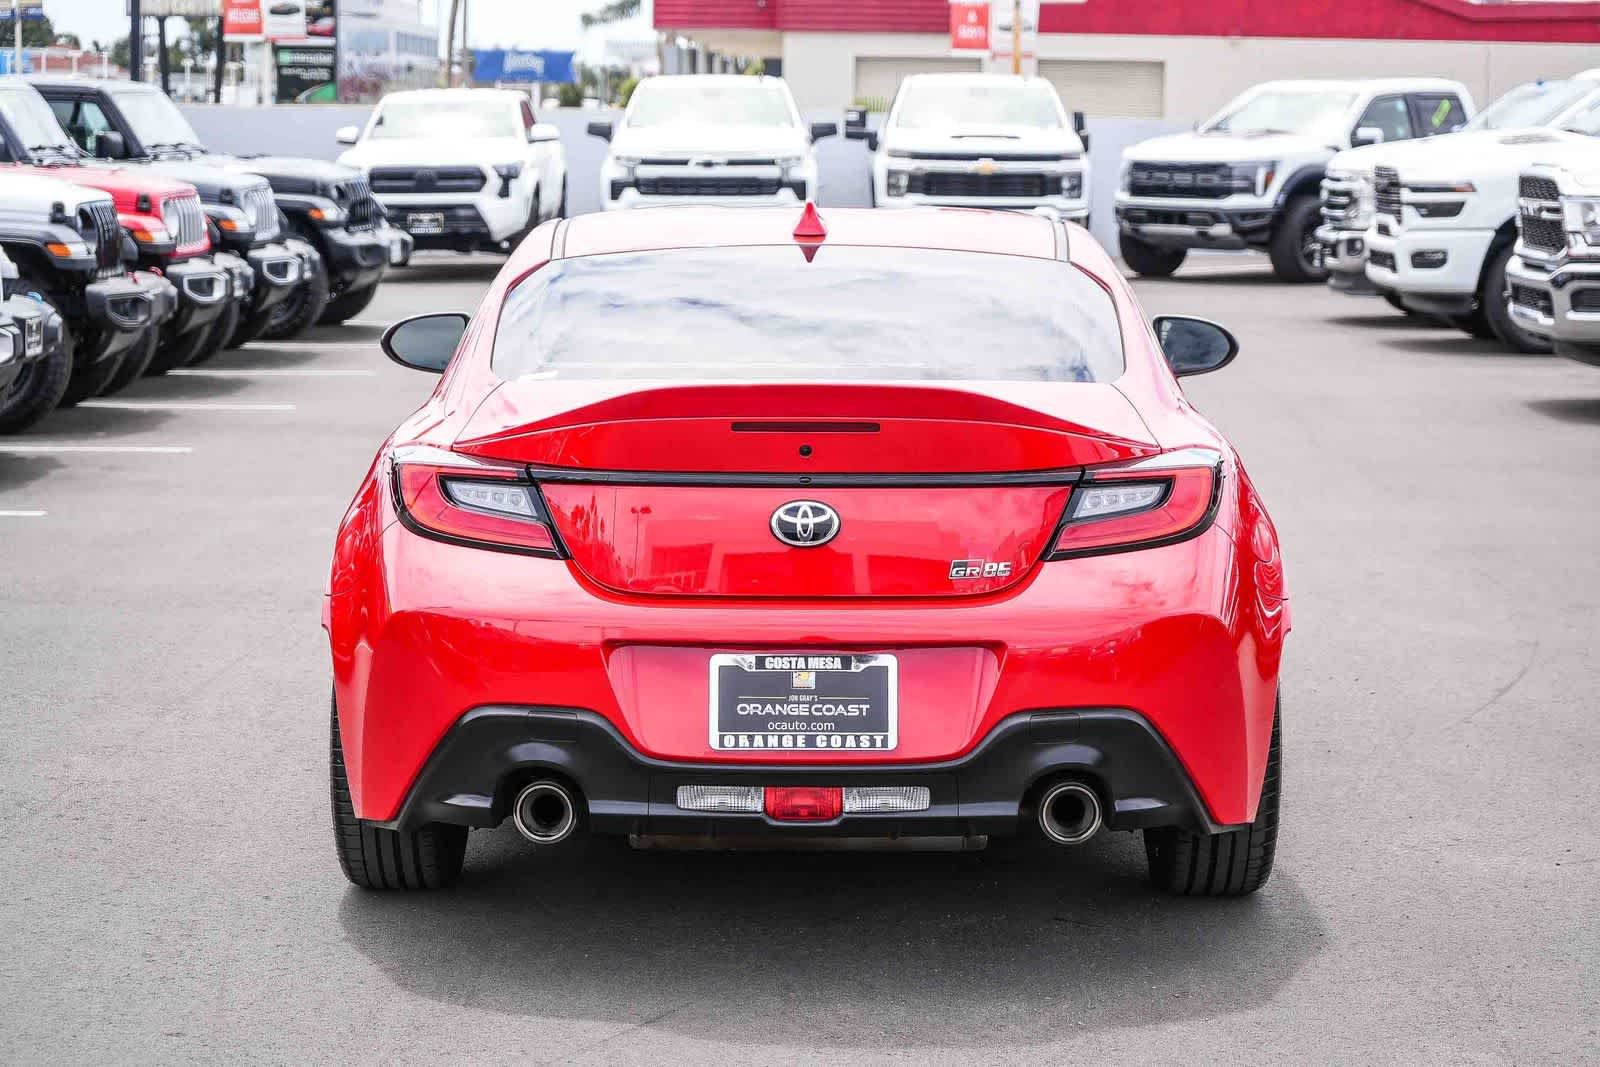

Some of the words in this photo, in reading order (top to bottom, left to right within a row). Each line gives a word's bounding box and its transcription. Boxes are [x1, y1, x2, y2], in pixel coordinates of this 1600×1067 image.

[764, 656, 806, 670] COSTA
[807, 656, 842, 670] MESA
[736, 703, 810, 716] ORANGE
[811, 703, 870, 716] COAST
[767, 719, 835, 731] ocauto.com
[723, 734, 807, 748] ORANGE
[815, 734, 884, 748] COAST
